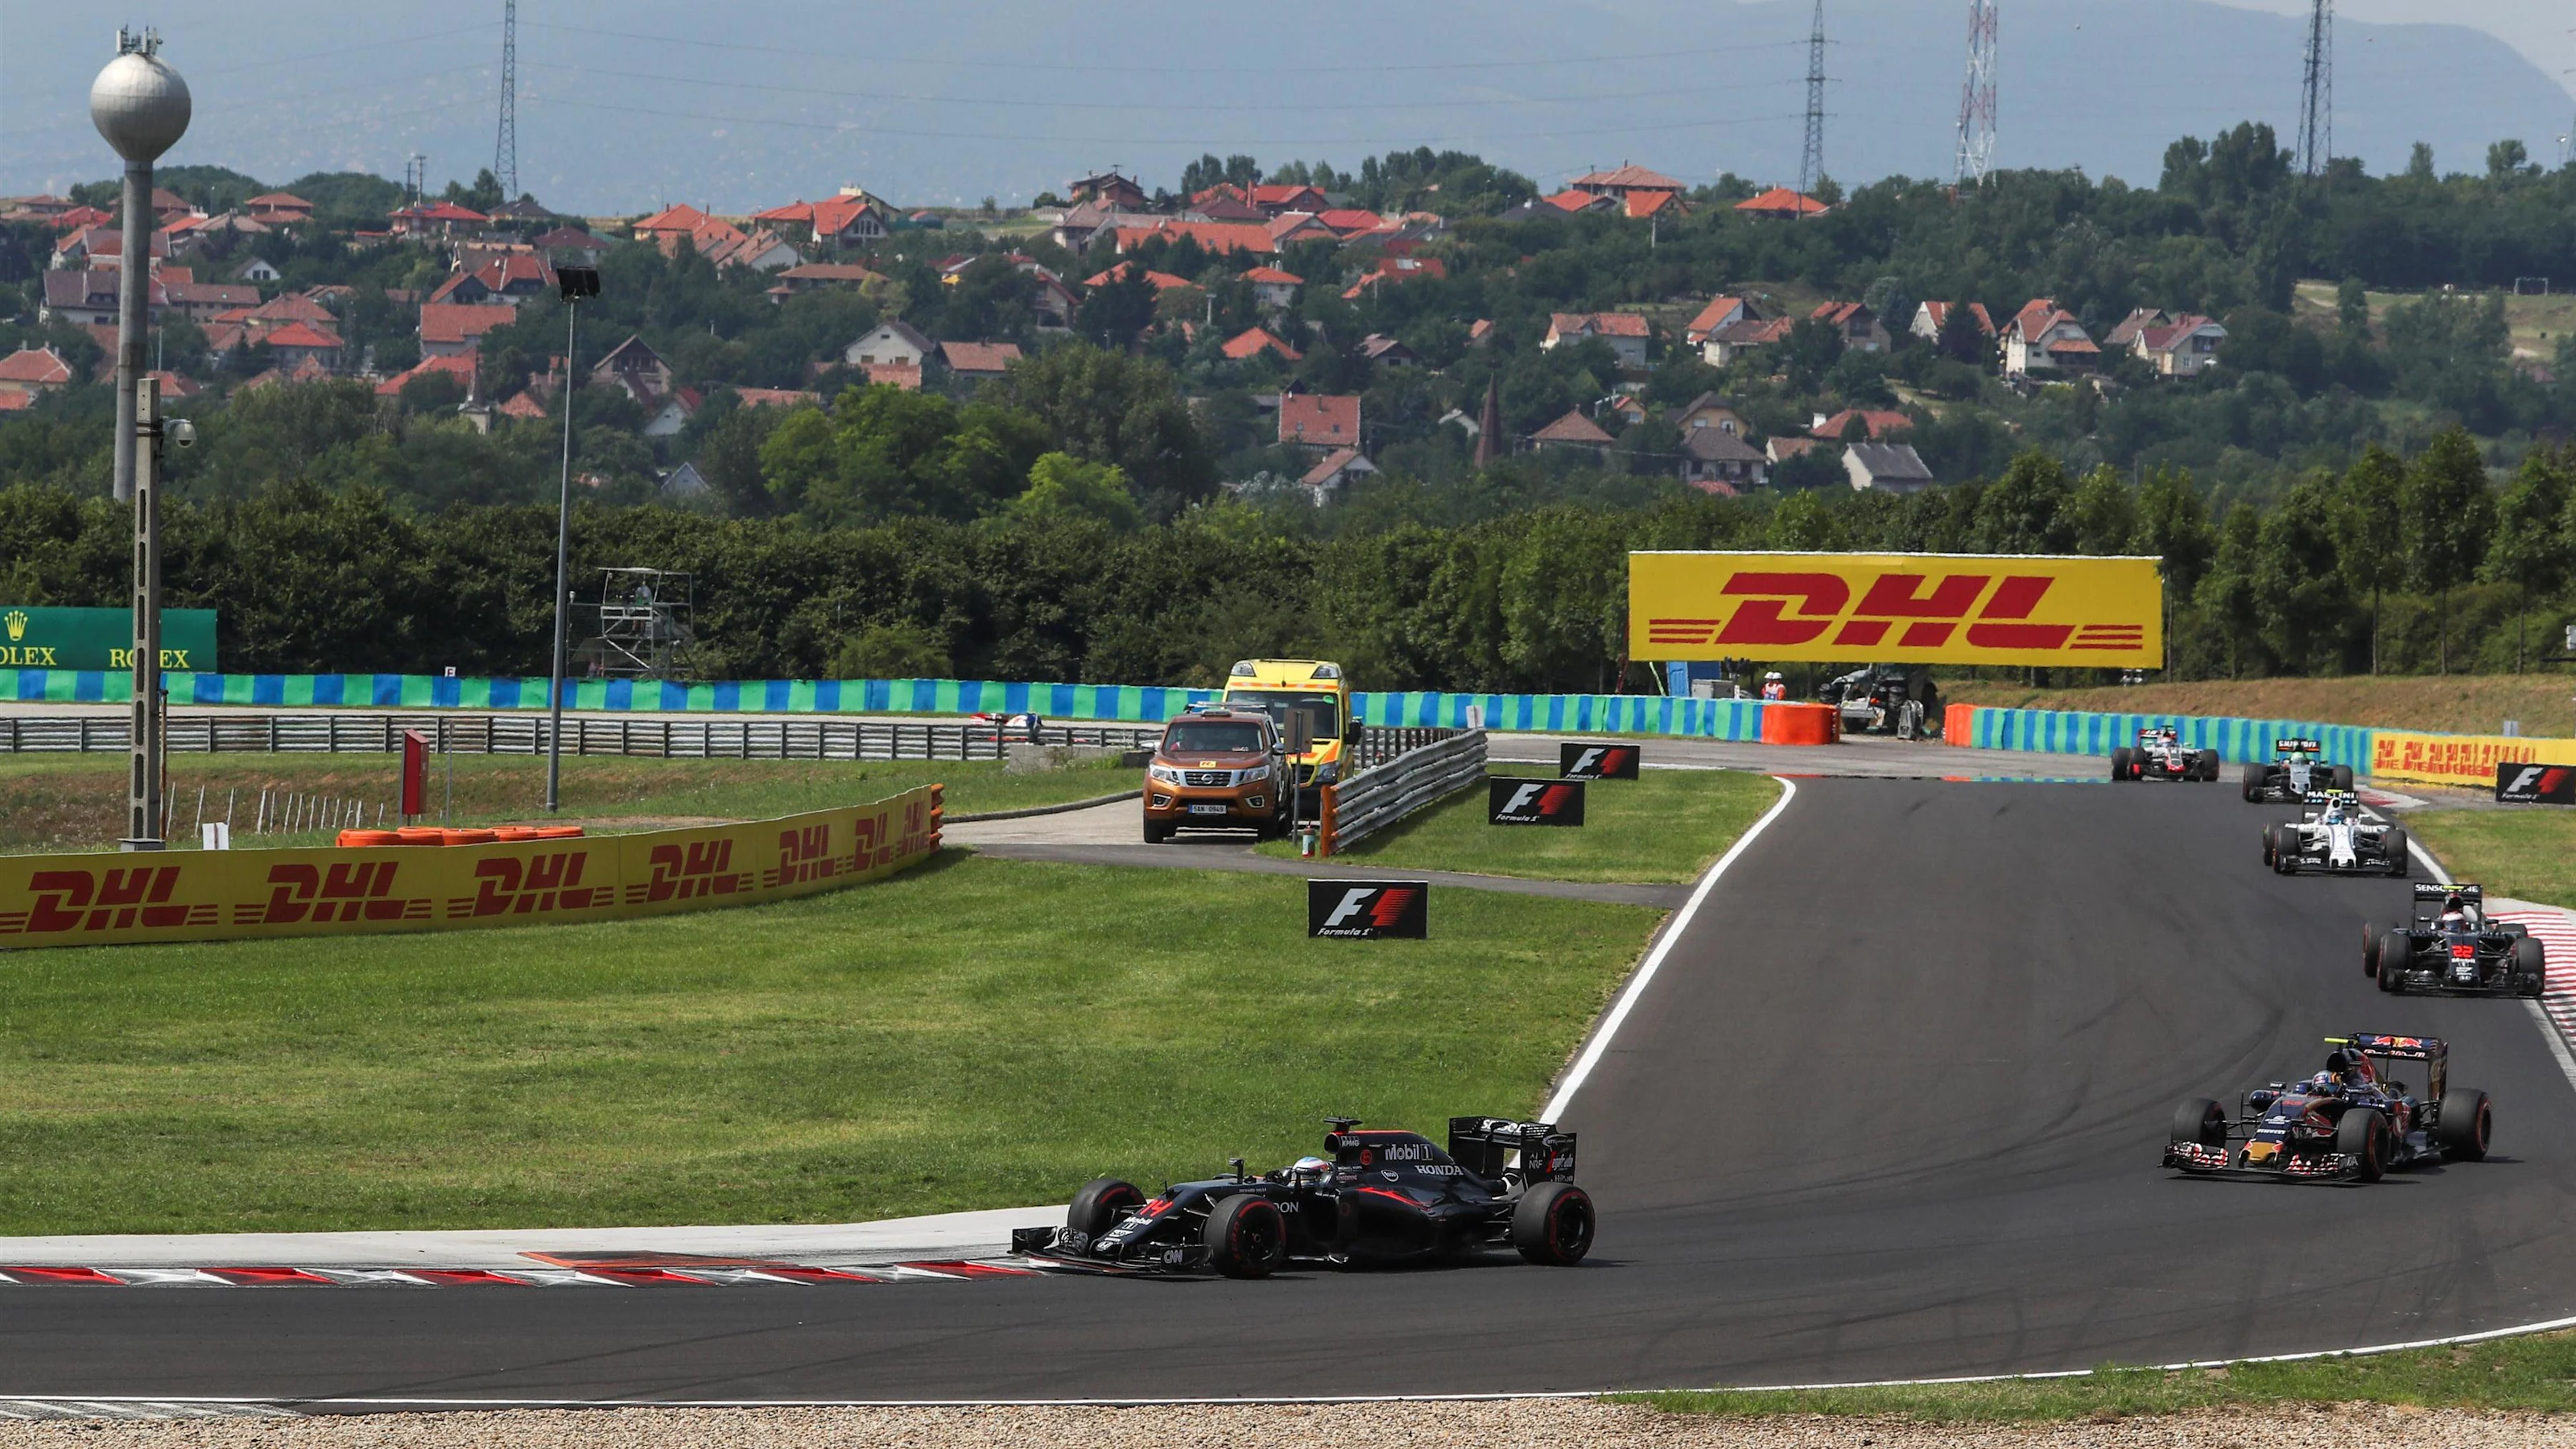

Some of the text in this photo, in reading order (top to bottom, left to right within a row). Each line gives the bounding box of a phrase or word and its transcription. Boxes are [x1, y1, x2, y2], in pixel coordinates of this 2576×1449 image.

[1715, 572, 2075, 649] DHL
[109, 649, 190, 669] REX
[1501, 783, 1576, 814] F1
[778, 824, 835, 886] DHL
[646, 840, 740, 902] DHL
[263, 862, 407, 923] DHL
[473, 852, 594, 917] DHL
[2415, 884, 2479, 893] SENSONE
[26, 866, 190, 932] DHL
[1323, 888, 1418, 926] F1
[1317, 927, 1360, 935] Formula
[2451, 945, 2474, 958] 22
[1385, 1144, 1420, 1161] Mobil
[1415, 1165, 1463, 1175] HONDA
[1140, 1199, 1174, 1217] 14
[1164, 1249, 1183, 1264] CNN
